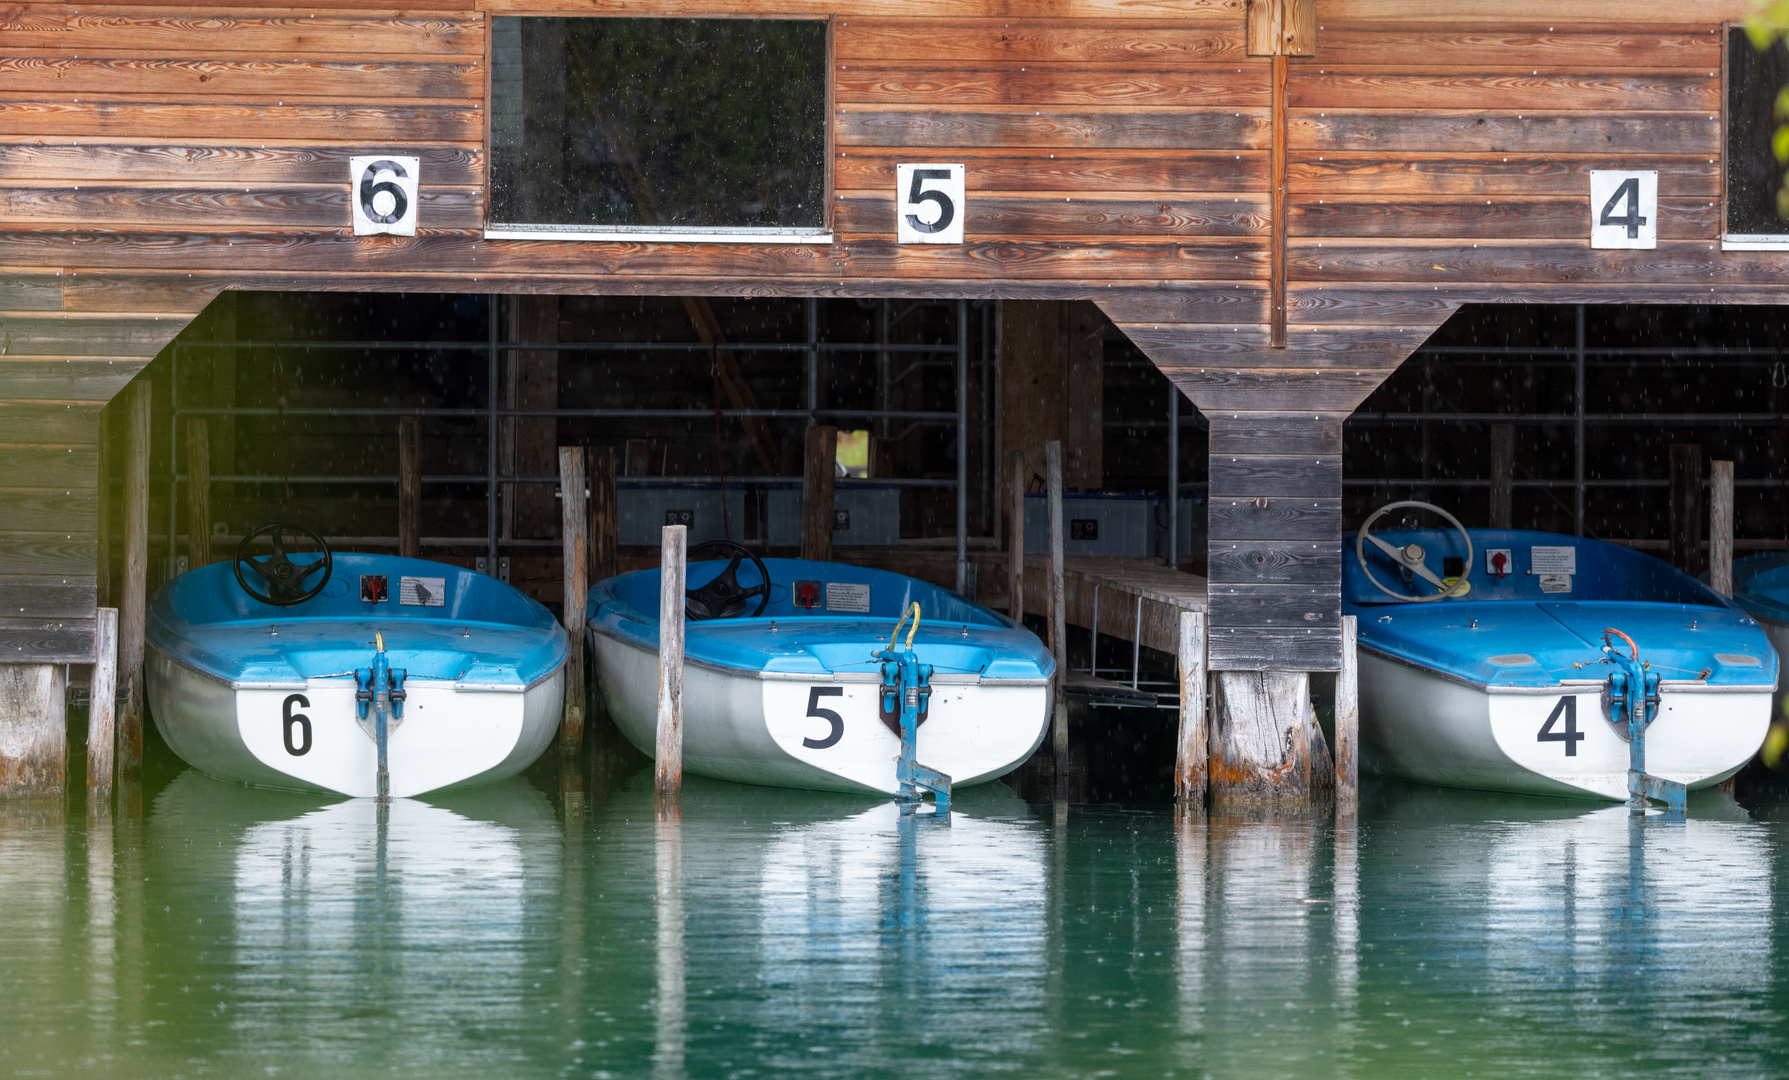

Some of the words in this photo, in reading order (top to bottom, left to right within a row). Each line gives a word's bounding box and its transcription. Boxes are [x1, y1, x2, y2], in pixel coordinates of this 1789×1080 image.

[360, 160, 408, 224] 6
[905, 169, 955, 234] 5
[1600, 178, 1647, 239] 4
[282, 693, 312, 757] 6
[803, 686, 844, 750] 5
[1537, 695, 1585, 757] 4
